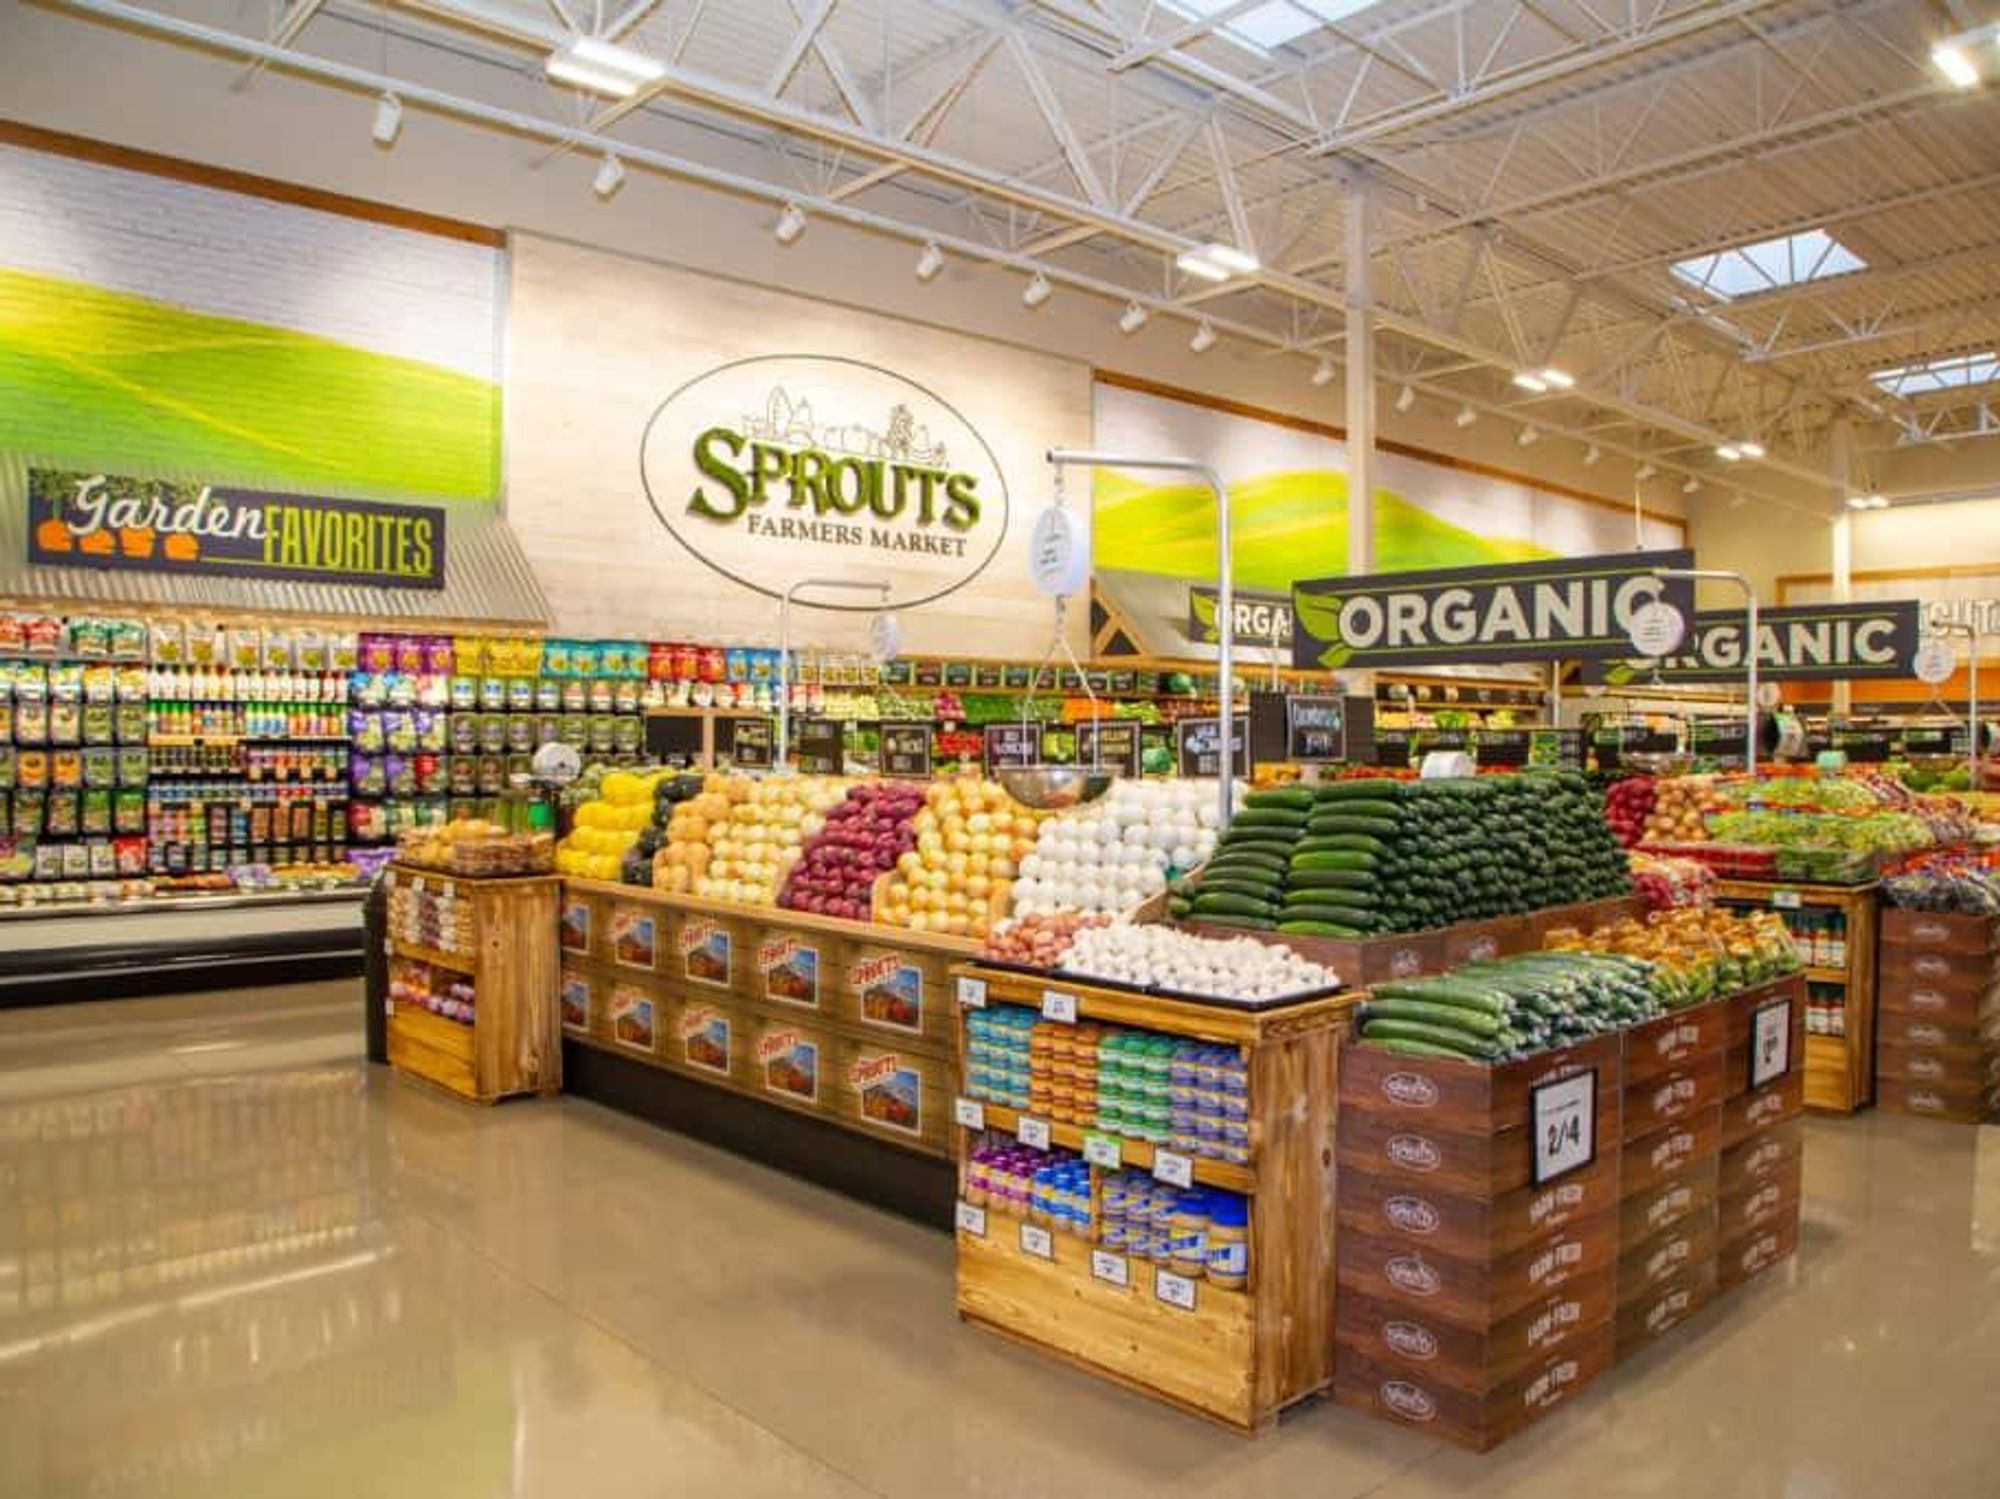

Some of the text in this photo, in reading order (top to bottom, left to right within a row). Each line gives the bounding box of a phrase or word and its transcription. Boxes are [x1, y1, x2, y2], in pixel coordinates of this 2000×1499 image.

[686, 427, 981, 531] SPROUTS
[68, 474, 433, 574] Garden FAVORITES
[748, 514, 967, 557] FARMERS MARKET
[1338, 576, 1665, 649] ORGANIC
[1547, 1116, 1581, 1156] 2/4
